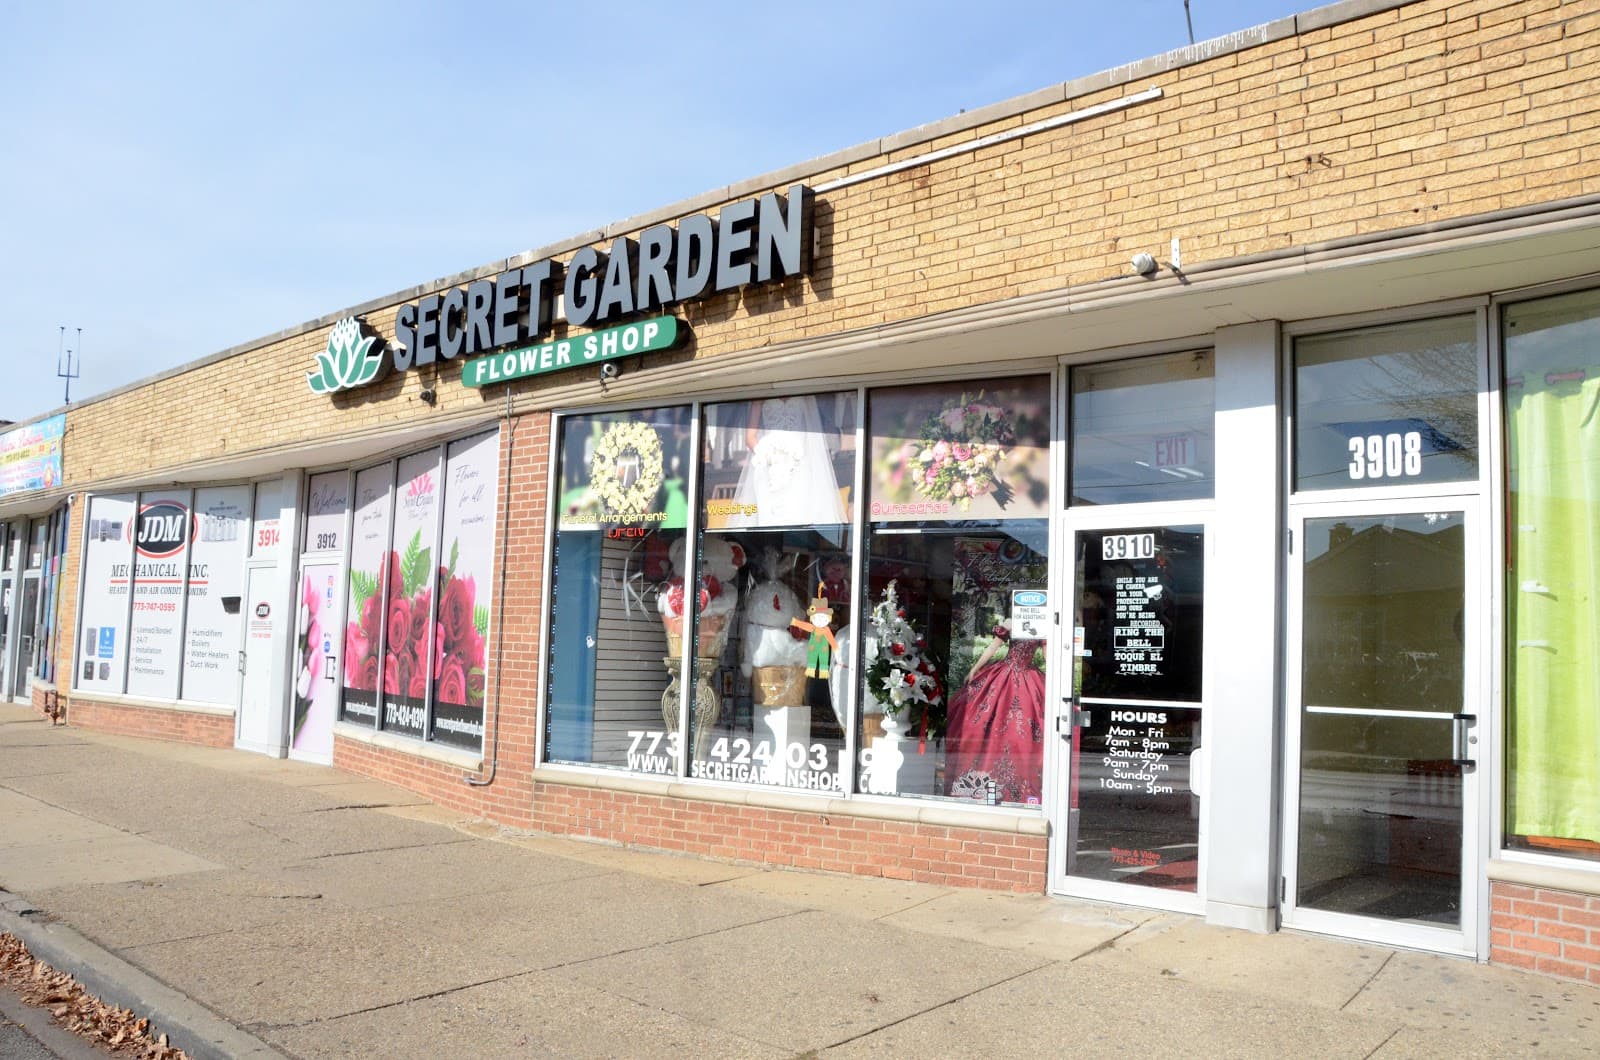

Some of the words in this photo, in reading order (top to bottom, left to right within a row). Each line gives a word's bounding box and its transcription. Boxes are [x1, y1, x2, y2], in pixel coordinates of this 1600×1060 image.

[394, 259, 551, 371] SECRET
[564, 184, 804, 326] GARDEN
[475, 341, 571, 382] FLOWER
[583, 321, 659, 359] SHOP
[1155, 438, 1187, 466] EXIT
[1348, 431, 1421, 479] 3908
[706, 503, 757, 516] Weddings
[561, 512, 598, 524] Funeral
[600, 511, 668, 525] Arrangements
[138, 515, 184, 543] JDM
[317, 533, 337, 549] 3912
[1104, 535, 1153, 559] 3910
[136, 586, 147, 595] AND
[149, 586, 159, 595] AIR
[192, 629, 223, 638] Humidifiers
[1115, 628, 1139, 636] RING
[1145, 628, 1163, 636] THE
[1127, 639, 1151, 647] BELL
[208, 651, 230, 659] Heaters
[1114, 653, 1145, 662] TOQUE
[1150, 653, 1163, 661] EL
[134, 667, 164, 675] Maintenance
[1120, 664, 1157, 672] TIMBRE
[1111, 711, 1167, 724] HOURS
[1109, 726, 1136, 737] Mon
[1148, 728, 1164, 738] Fri
[1105, 735, 1130, 747] 7am
[1142, 738, 1170, 751] 8pm
[627, 731, 679, 757] 773
[711, 737, 772, 767] 424
[786, 742, 828, 771] 03
[1109, 747, 1163, 762] Saturday
[1103, 757, 1129, 768] 9am
[1142, 760, 1169, 773] 7pm
[1113, 769, 1158, 785] Sunday
[1100, 778, 1133, 790] 10am
[1146, 783, 1172, 795] 5pm
[1141, 850, 1160, 859] Video
